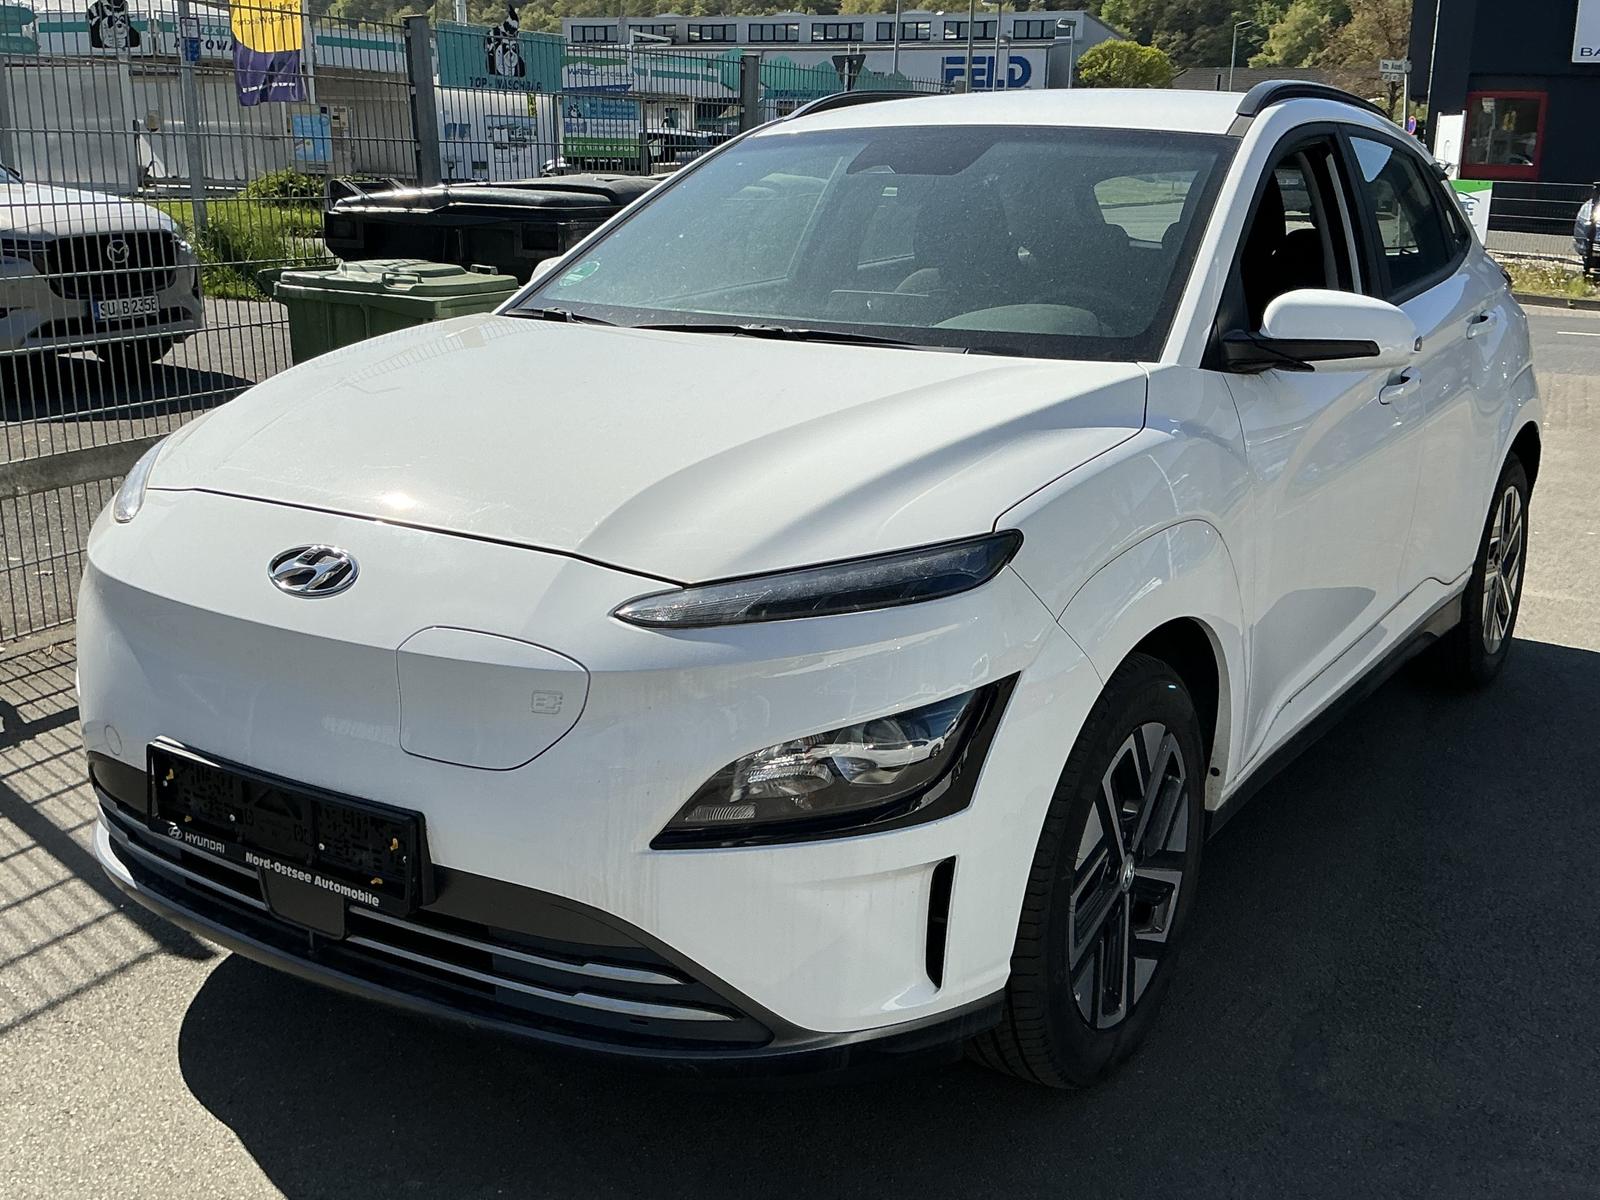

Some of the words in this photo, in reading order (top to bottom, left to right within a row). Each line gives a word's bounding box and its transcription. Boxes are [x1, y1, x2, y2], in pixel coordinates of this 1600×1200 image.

[945, 56, 1031, 88] FELD
[100, 302, 115, 317] SU
[184, 831, 225, 854] HYUNDAI
[245, 851, 312, 883] Nord-Ostsee
[314, 875, 380, 907] Automobile
